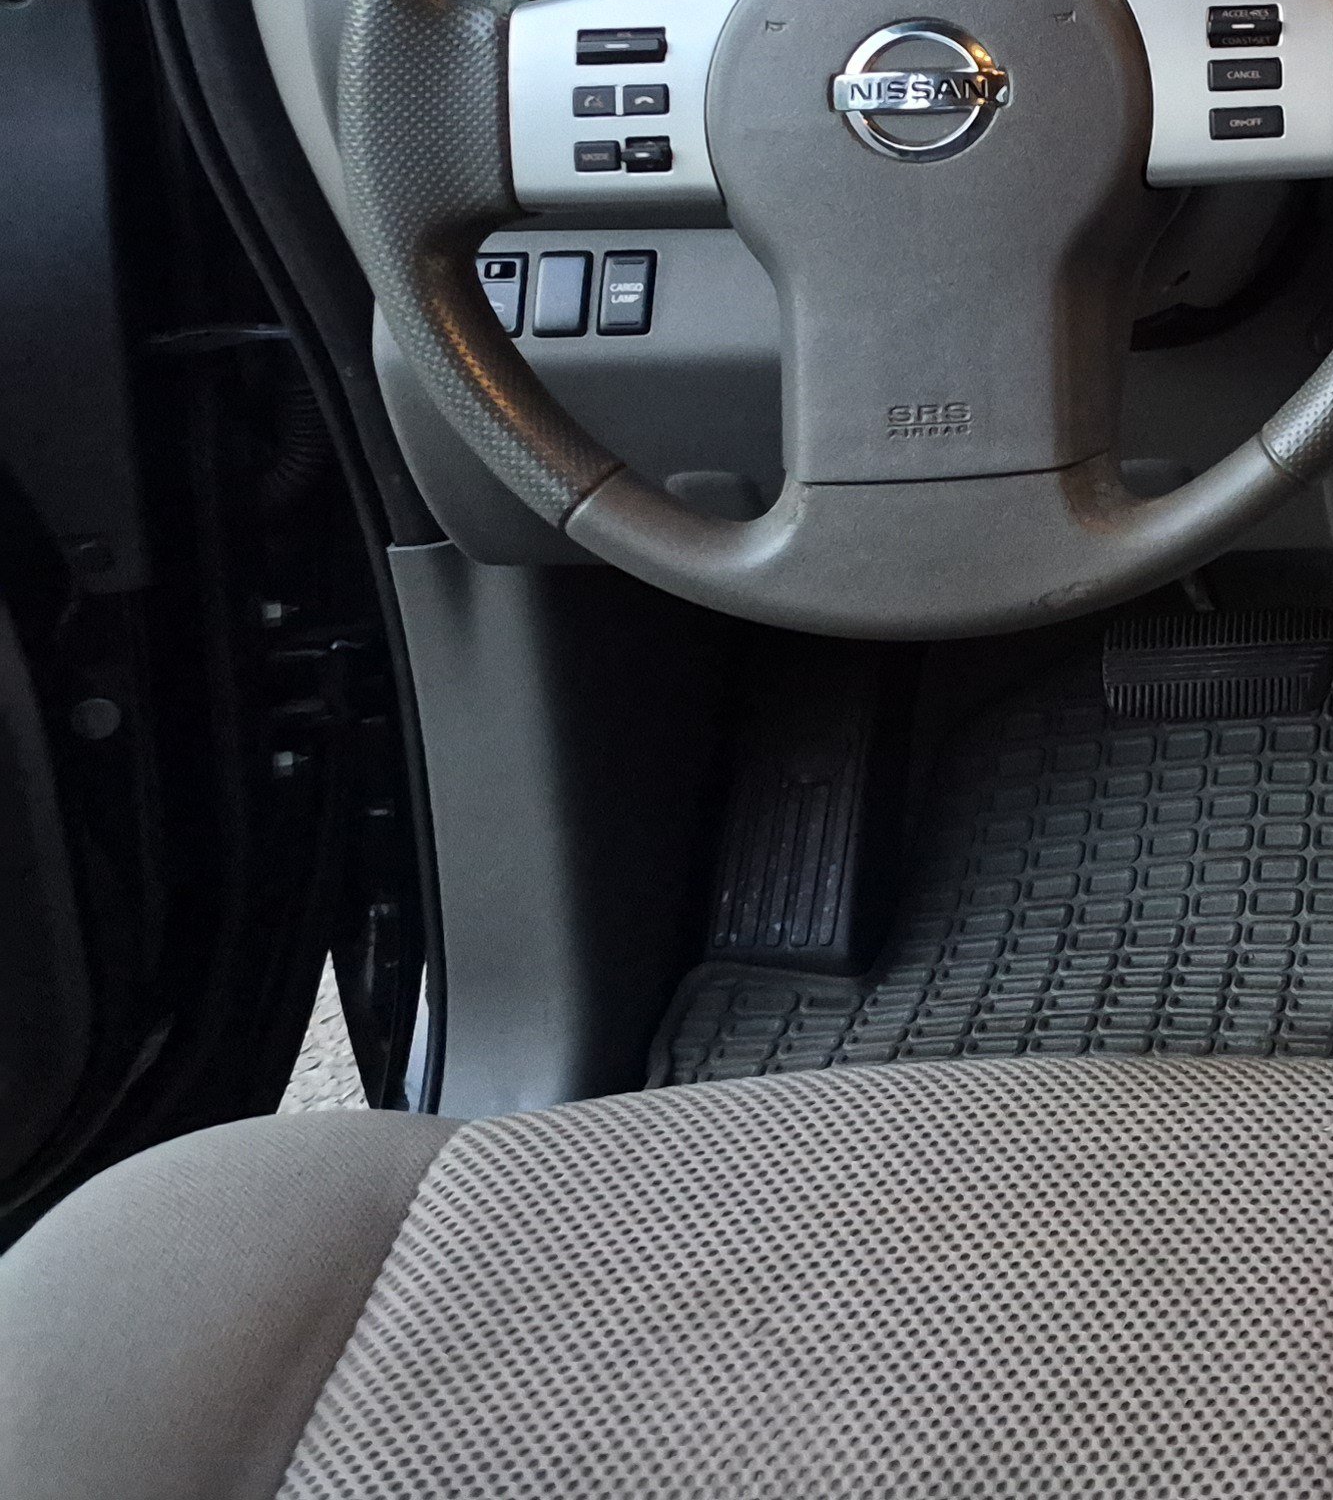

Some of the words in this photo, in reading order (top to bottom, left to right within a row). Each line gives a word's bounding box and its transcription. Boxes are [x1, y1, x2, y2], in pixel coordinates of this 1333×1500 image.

[1227, 70, 1261, 79] CANCEL
[850, 79, 988, 101] NISSAN
[609, 282, 644, 292] CARGO
[611, 294, 640, 304] LAMP
[887, 403, 971, 422] SRS
